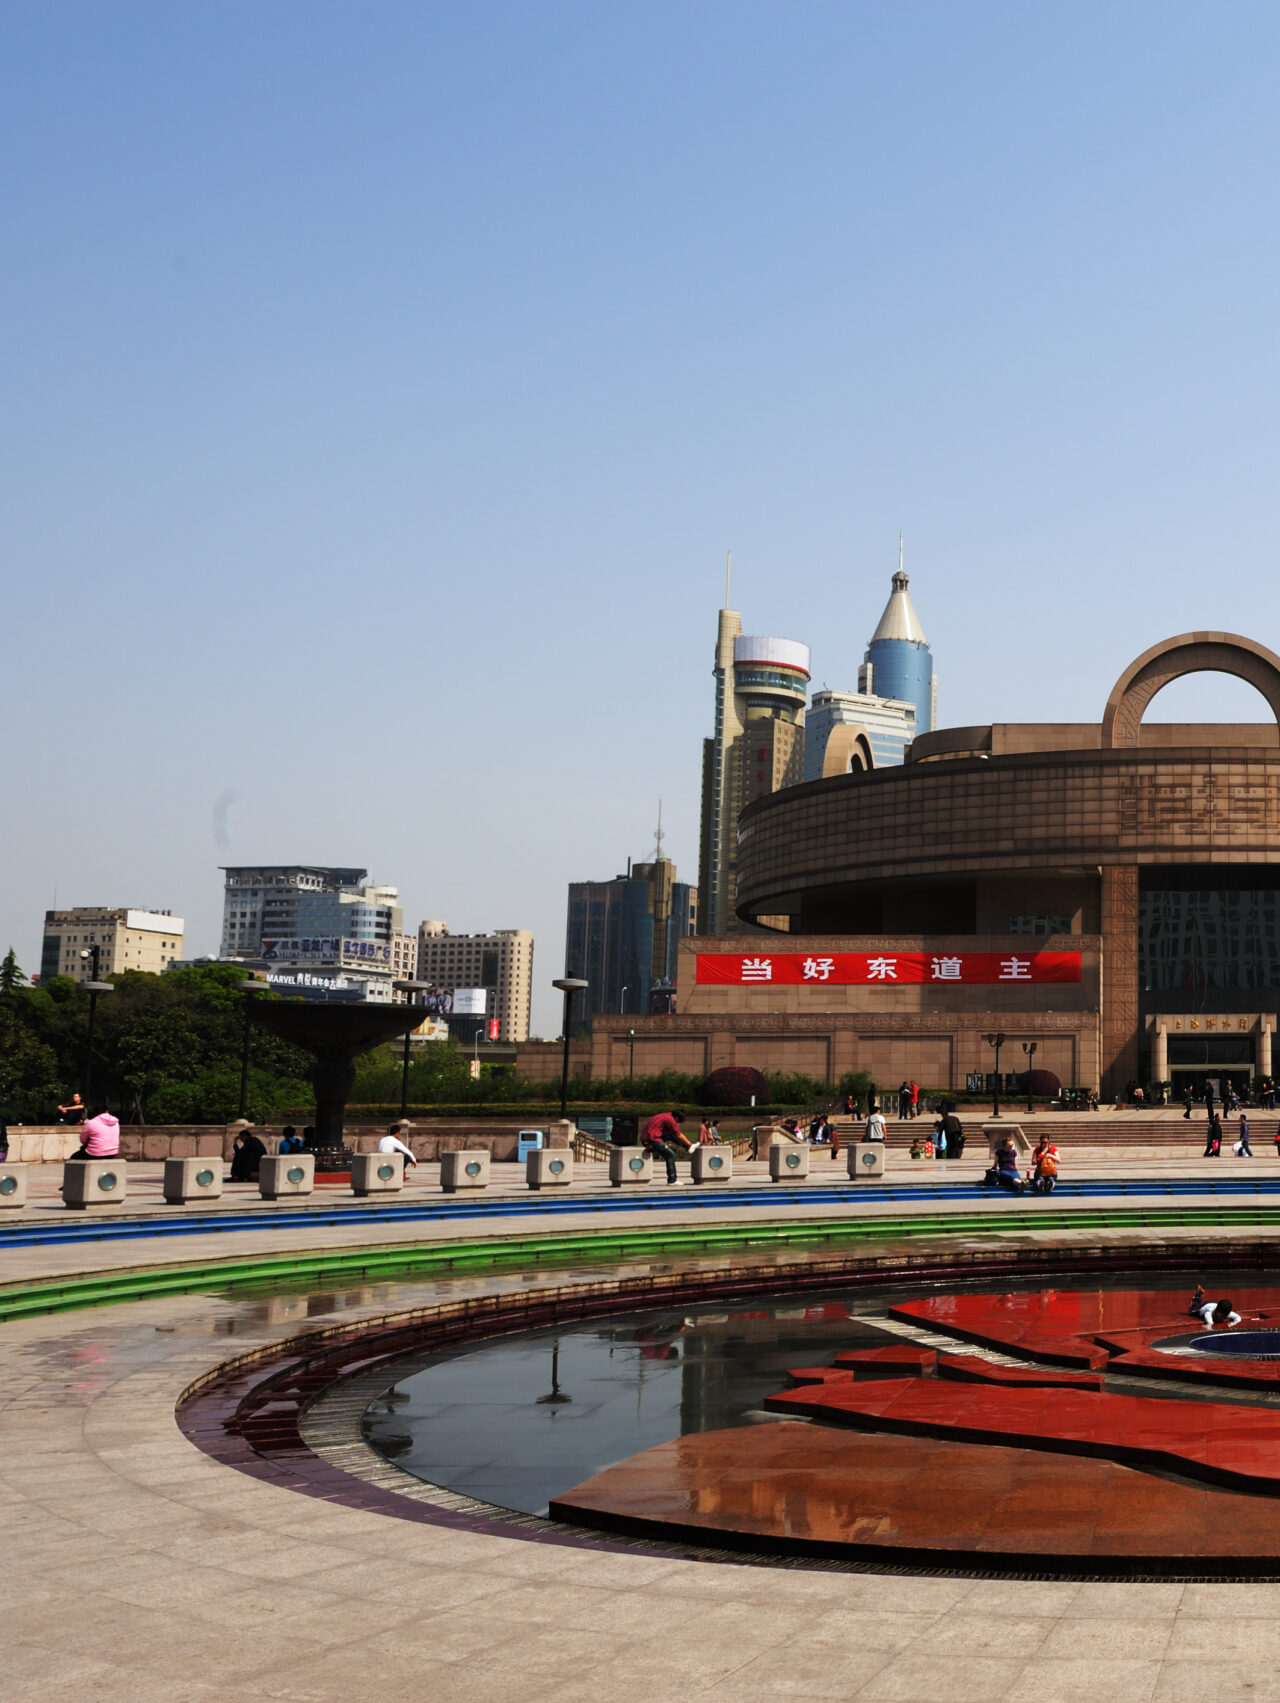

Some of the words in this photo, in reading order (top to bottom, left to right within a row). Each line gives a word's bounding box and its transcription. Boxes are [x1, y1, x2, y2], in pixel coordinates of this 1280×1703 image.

[741, 956, 1032, 981] 当好东道主
[266, 974, 296, 985] MARVEL
